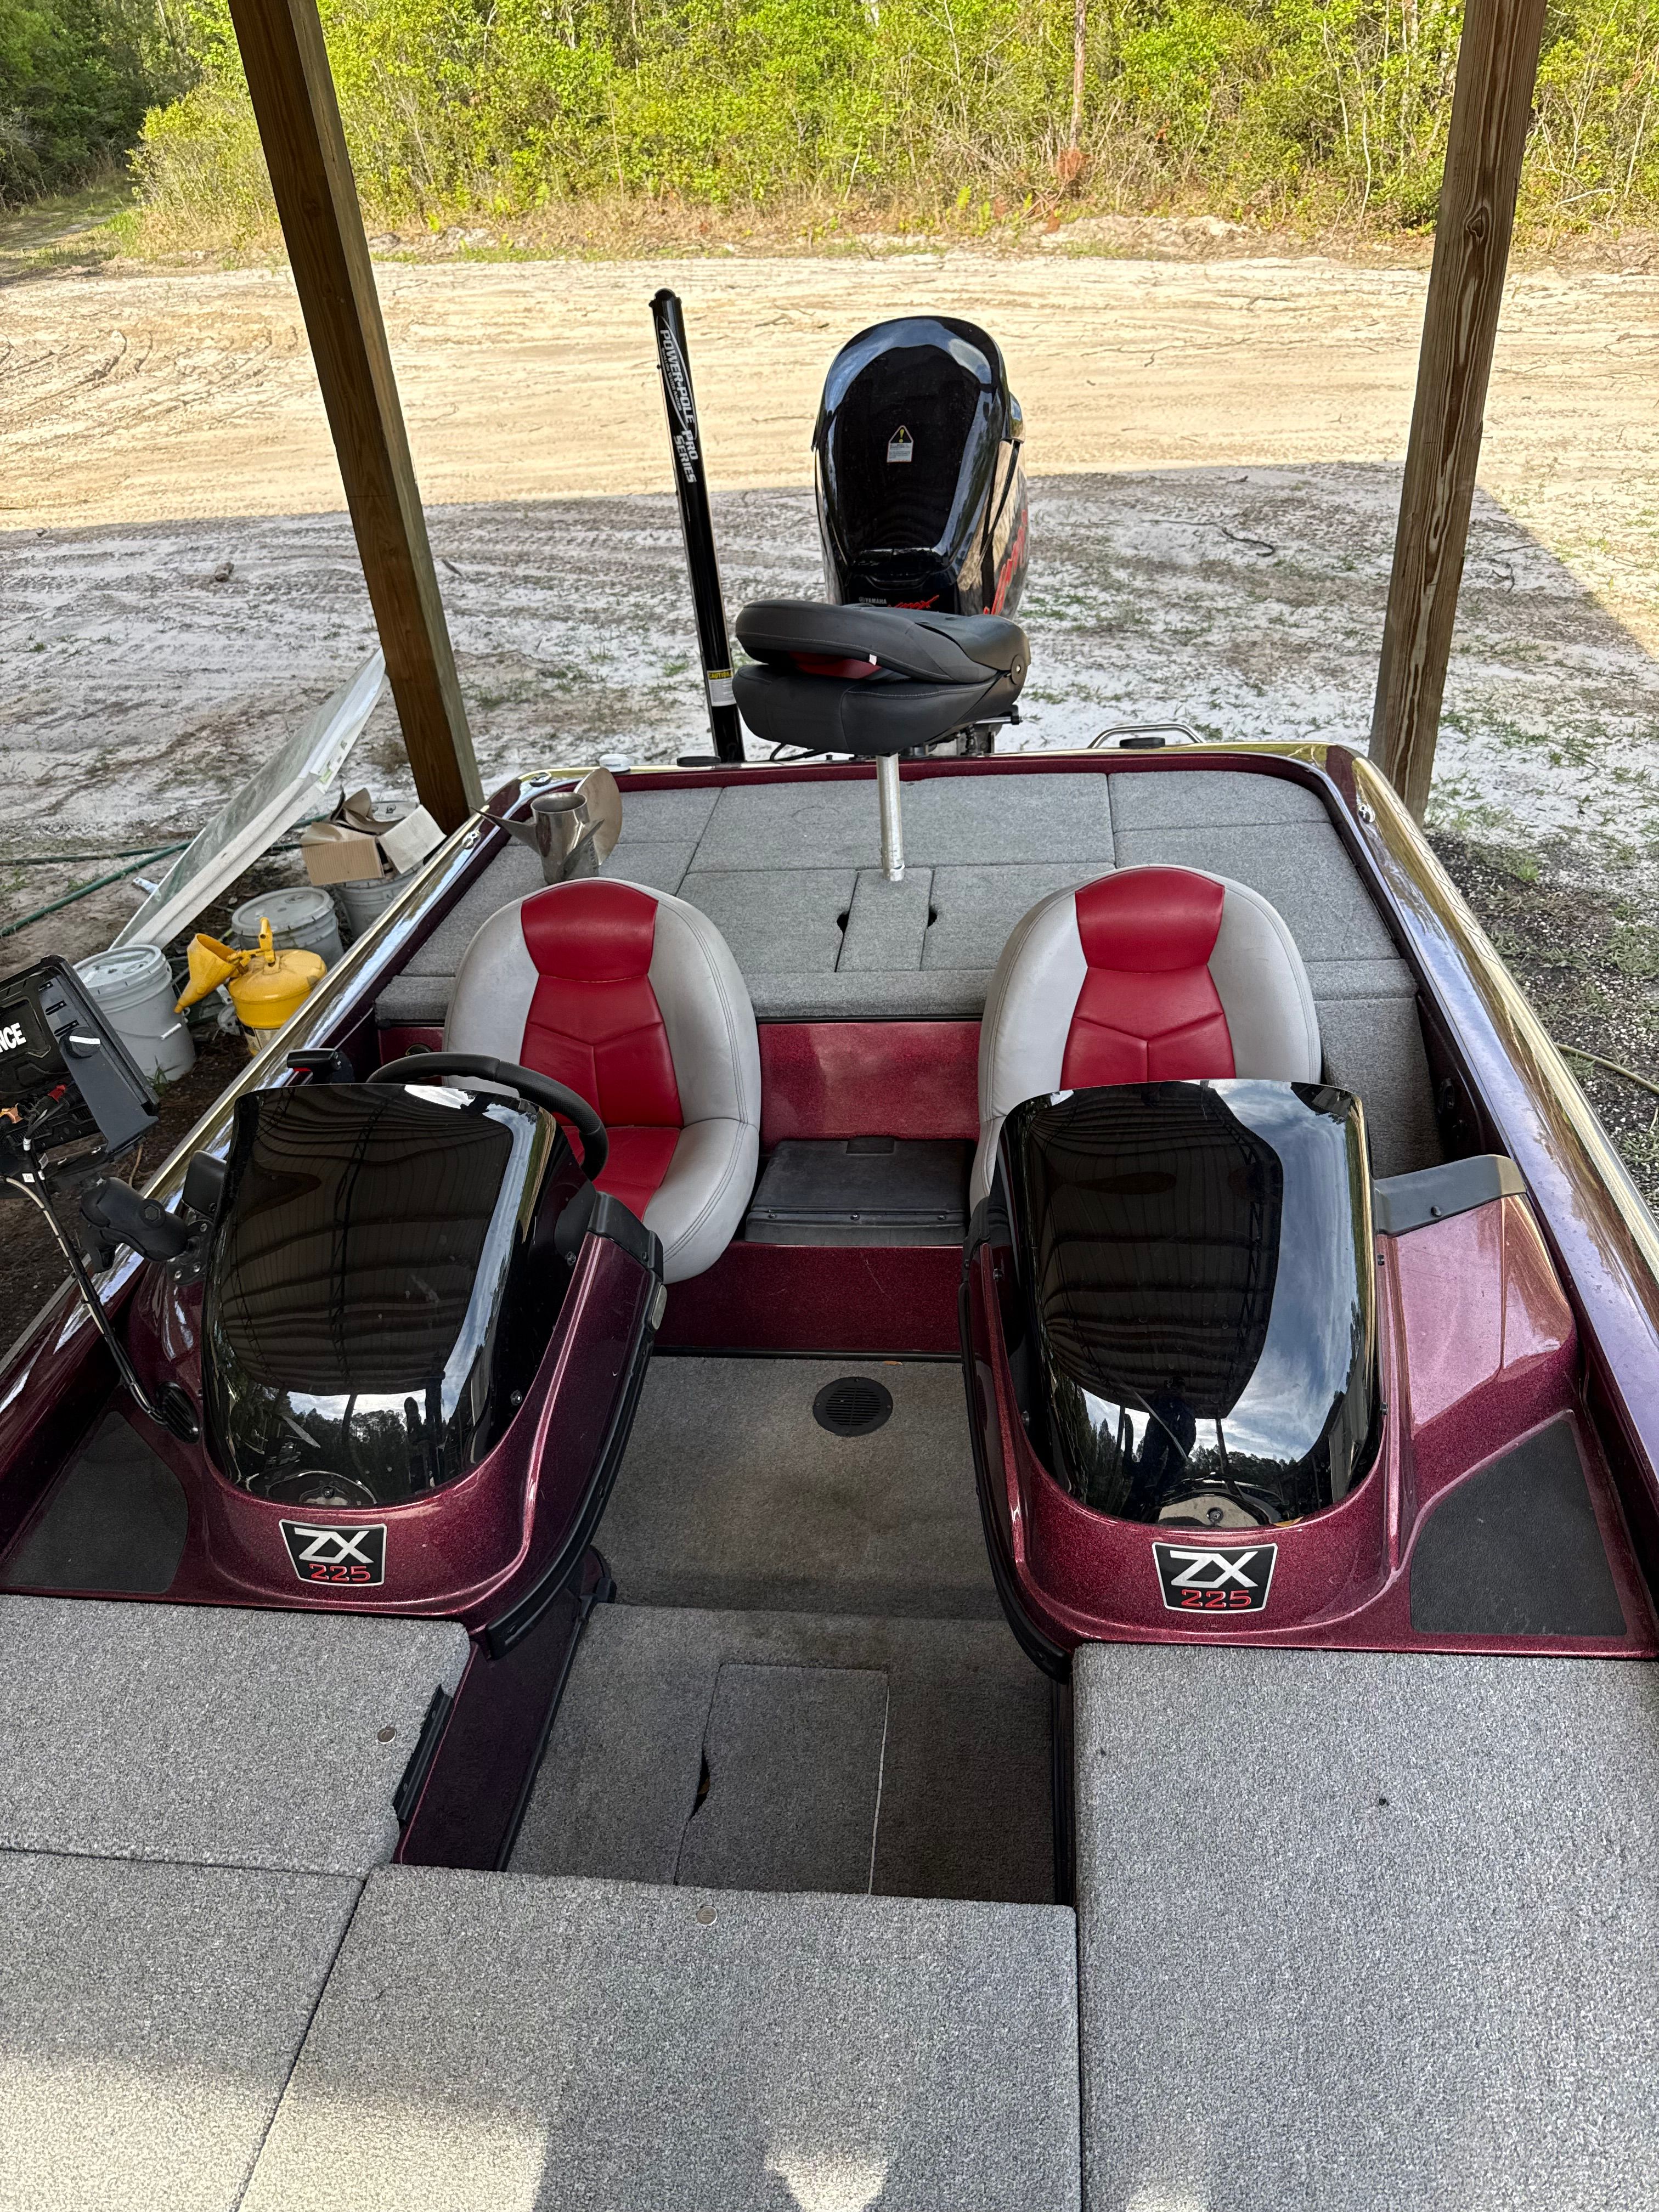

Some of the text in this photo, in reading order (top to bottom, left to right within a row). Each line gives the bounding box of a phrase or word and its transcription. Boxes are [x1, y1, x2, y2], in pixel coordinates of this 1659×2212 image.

[660, 330, 695, 424] POWER-POLE
[673, 435, 697, 483] SERIES
[682, 430, 698, 460] PRO
[294, 1527, 375, 1564] ZX
[309, 1564, 371, 1582] 225
[1169, 1550, 1259, 1589] ZX
[1181, 1589, 1251, 1608] 225
